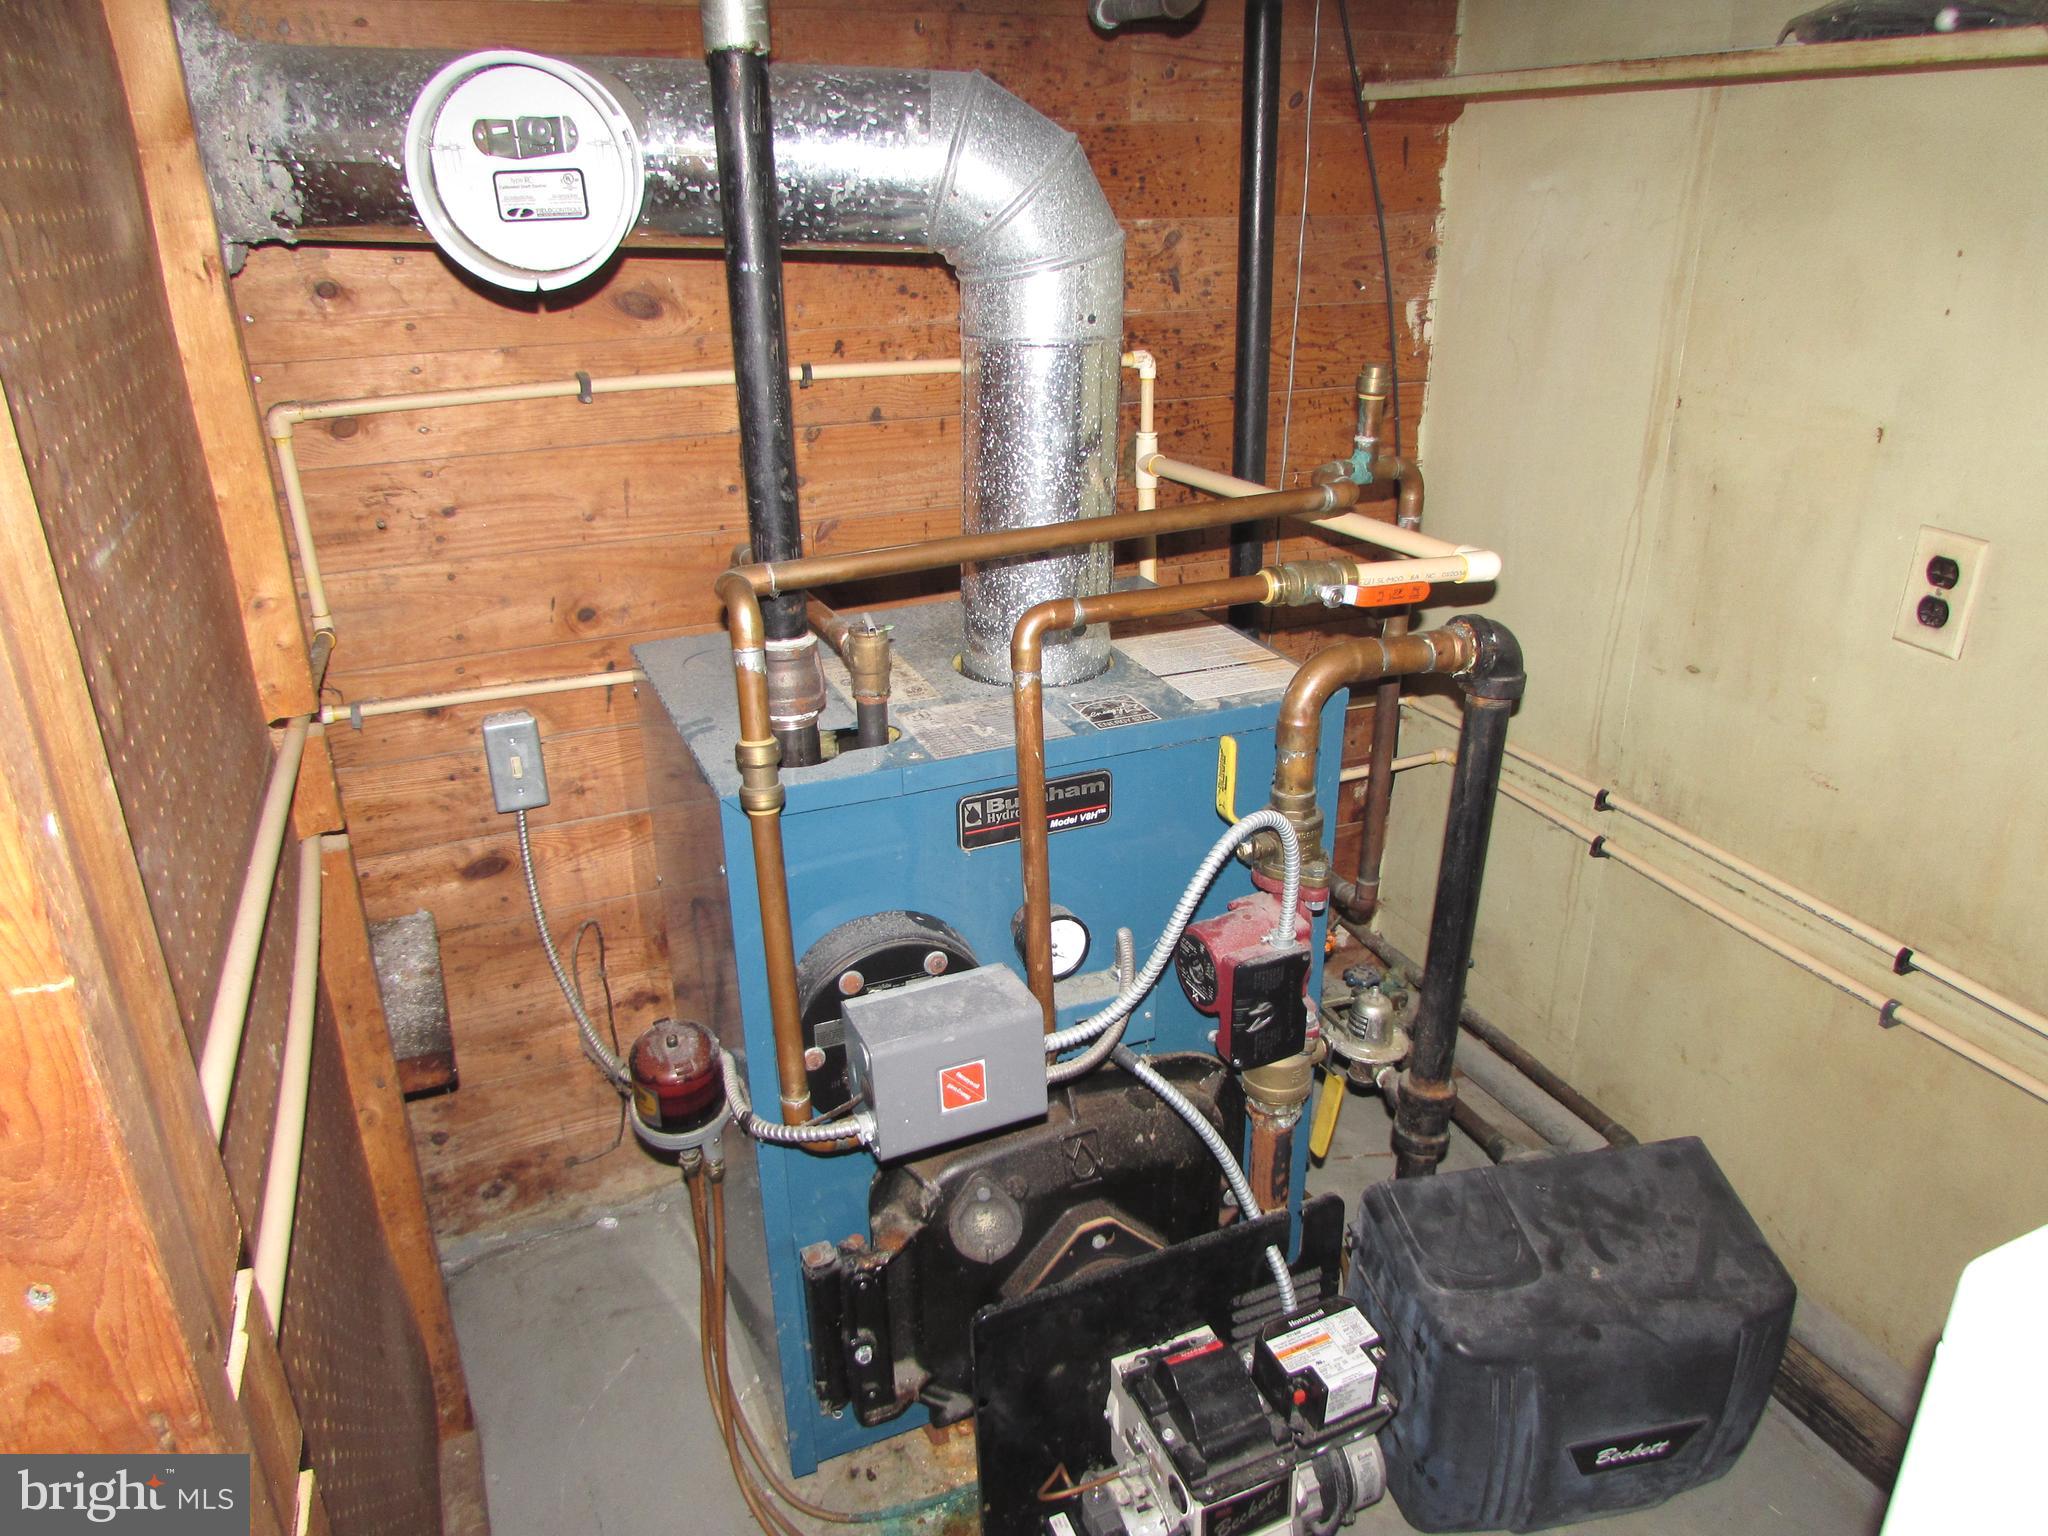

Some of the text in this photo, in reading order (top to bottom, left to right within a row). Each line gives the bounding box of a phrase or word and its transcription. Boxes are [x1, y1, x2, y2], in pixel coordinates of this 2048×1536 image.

[986, 781, 1105, 812] Buham
[1050, 816, 1077, 828] Model
[1288, 1309, 1325, 1328] Honeywell
[1595, 1440, 1670, 1465] Beckett
